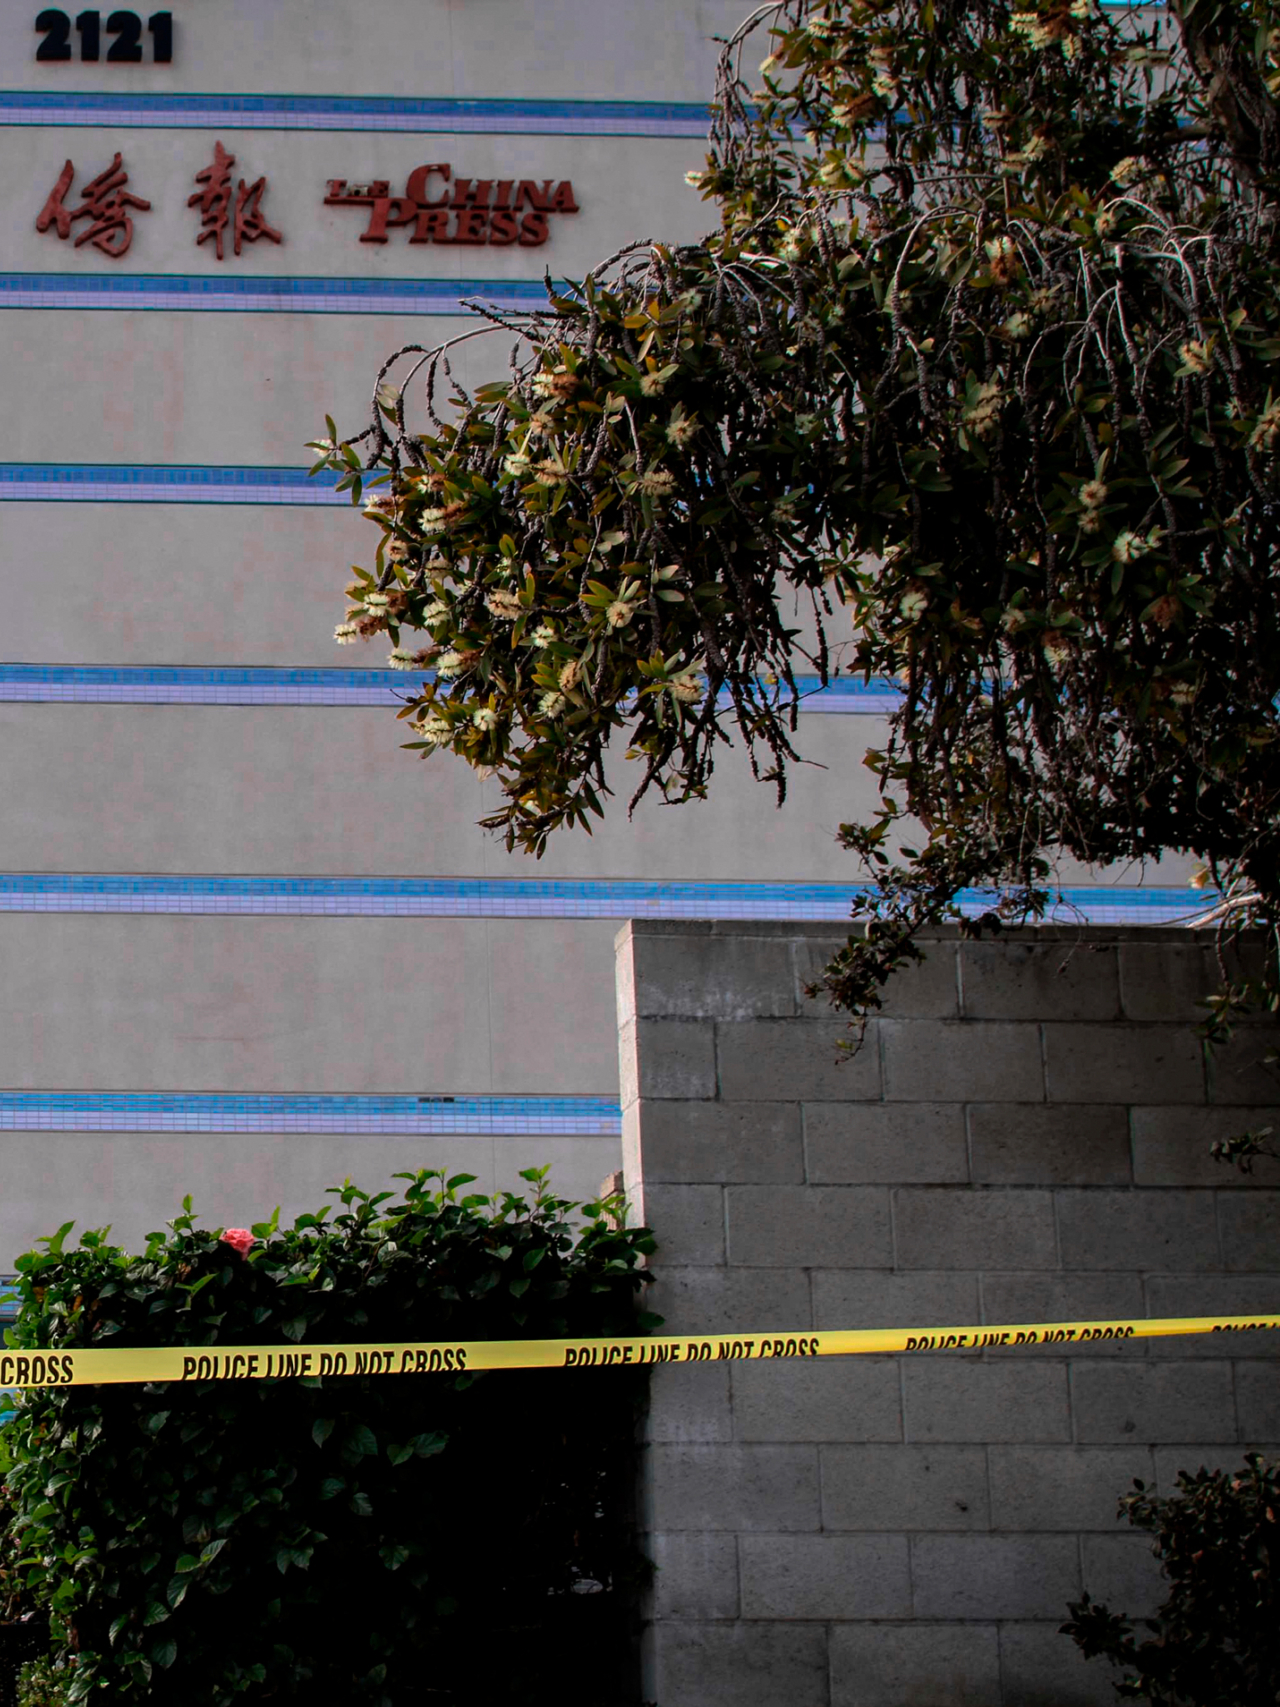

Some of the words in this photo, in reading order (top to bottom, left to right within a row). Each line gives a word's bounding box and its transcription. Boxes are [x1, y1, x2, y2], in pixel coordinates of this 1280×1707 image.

[35, 10, 173, 62] 2121
[36, 141, 282, 260] 僑報
[326, 179, 390, 198] TE
[406, 163, 579, 213] CHINA
[359, 197, 550, 247] PRESS
[0, 1355, 74, 1386] CROSS
[182, 1354, 259, 1380] POLICE
[265, 1353, 312, 1378] LINE
[318, 1352, 348, 1376] DO
[353, 1351, 395, 1375] NOT
[400, 1347, 467, 1373] CROSS
[564, 1345, 633, 1366] POLICE
[686, 1342, 712, 1361] DO
[717, 1341, 755, 1360] NOT
[758, 1338, 820, 1358] CROSS
